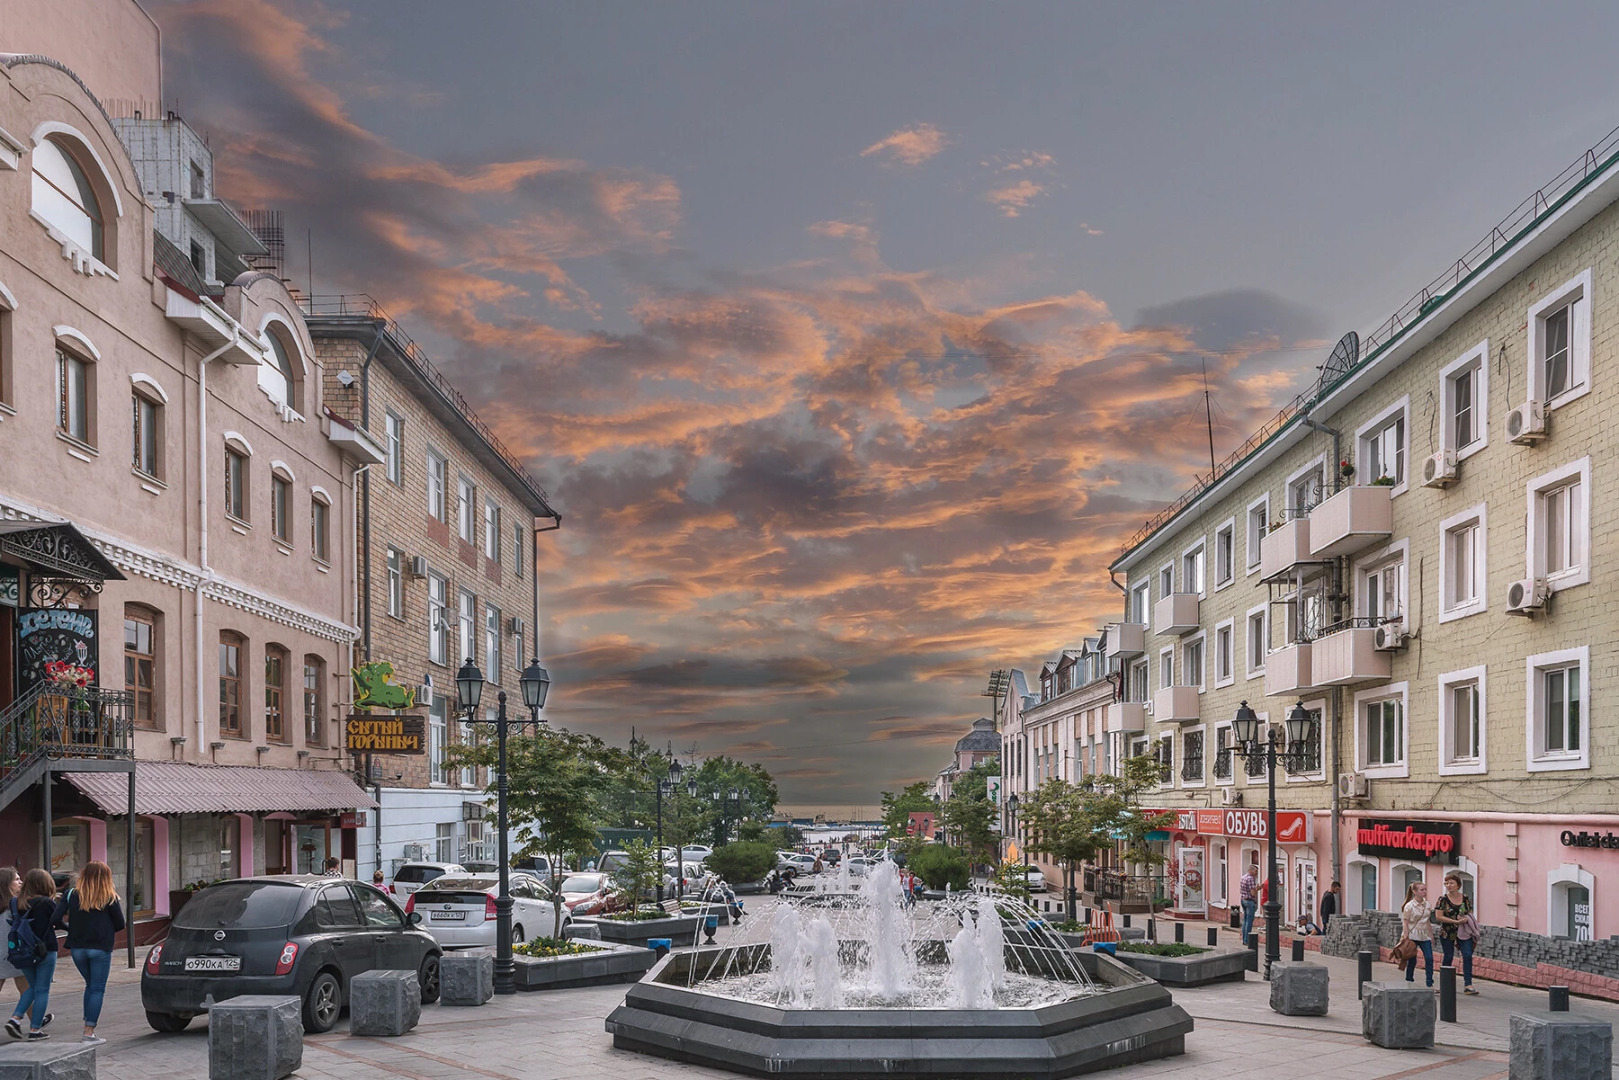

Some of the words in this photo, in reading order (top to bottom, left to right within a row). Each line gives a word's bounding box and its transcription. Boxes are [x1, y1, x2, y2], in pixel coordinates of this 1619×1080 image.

[347, 717, 404, 735] СЫТЫЙ
[348, 734, 419, 749] ГОРЫНЫЧ
[1226, 810, 1268, 837] ОБУВЬ
[1357, 823, 1454, 857] multivarka.pro
[1560, 830, 1601, 848] Outlet
